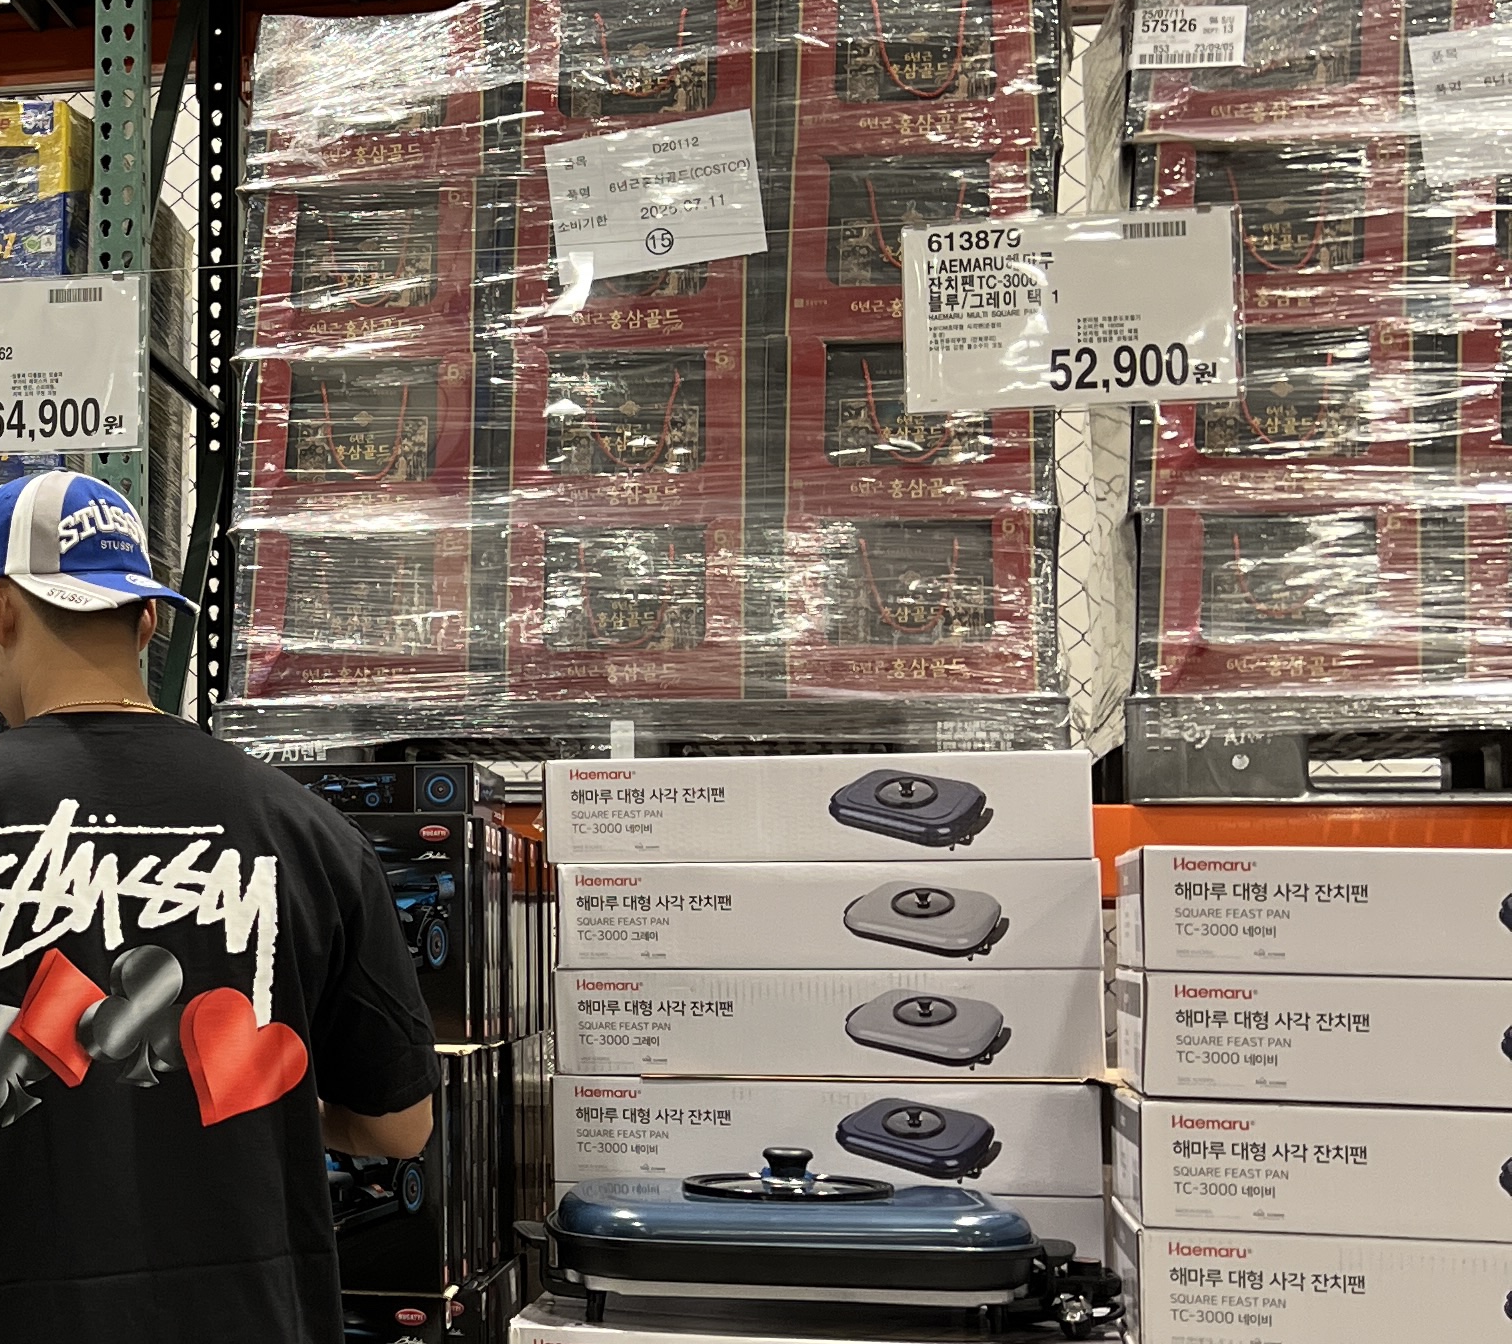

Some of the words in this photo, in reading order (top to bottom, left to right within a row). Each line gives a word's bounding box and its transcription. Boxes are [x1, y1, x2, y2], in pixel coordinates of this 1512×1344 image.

[1142, 18, 1196, 33] 575126
[653, 137, 699, 153] D20112
[927, 227, 1021, 252] 613879
[928, 290, 1016, 312] 블루/그레이
[1052, 290, 1058, 303] 1
[101, 540, 136, 554] STUSSY
[46, 588, 91, 605] STUSSY
[570, 769, 632, 780] Haemaru
[571, 789, 613, 804] 해마루
[617, 788, 644, 804] 대형
[649, 788, 678, 803] 사각
[682, 787, 725, 803] 잔치팬
[572, 810, 609, 819] SQUARE
[612, 810, 640, 818] FEAST
[644, 810, 663, 818] PAN
[572, 823, 622, 834] TC-3000
[625, 824, 652, 833] 네이비
